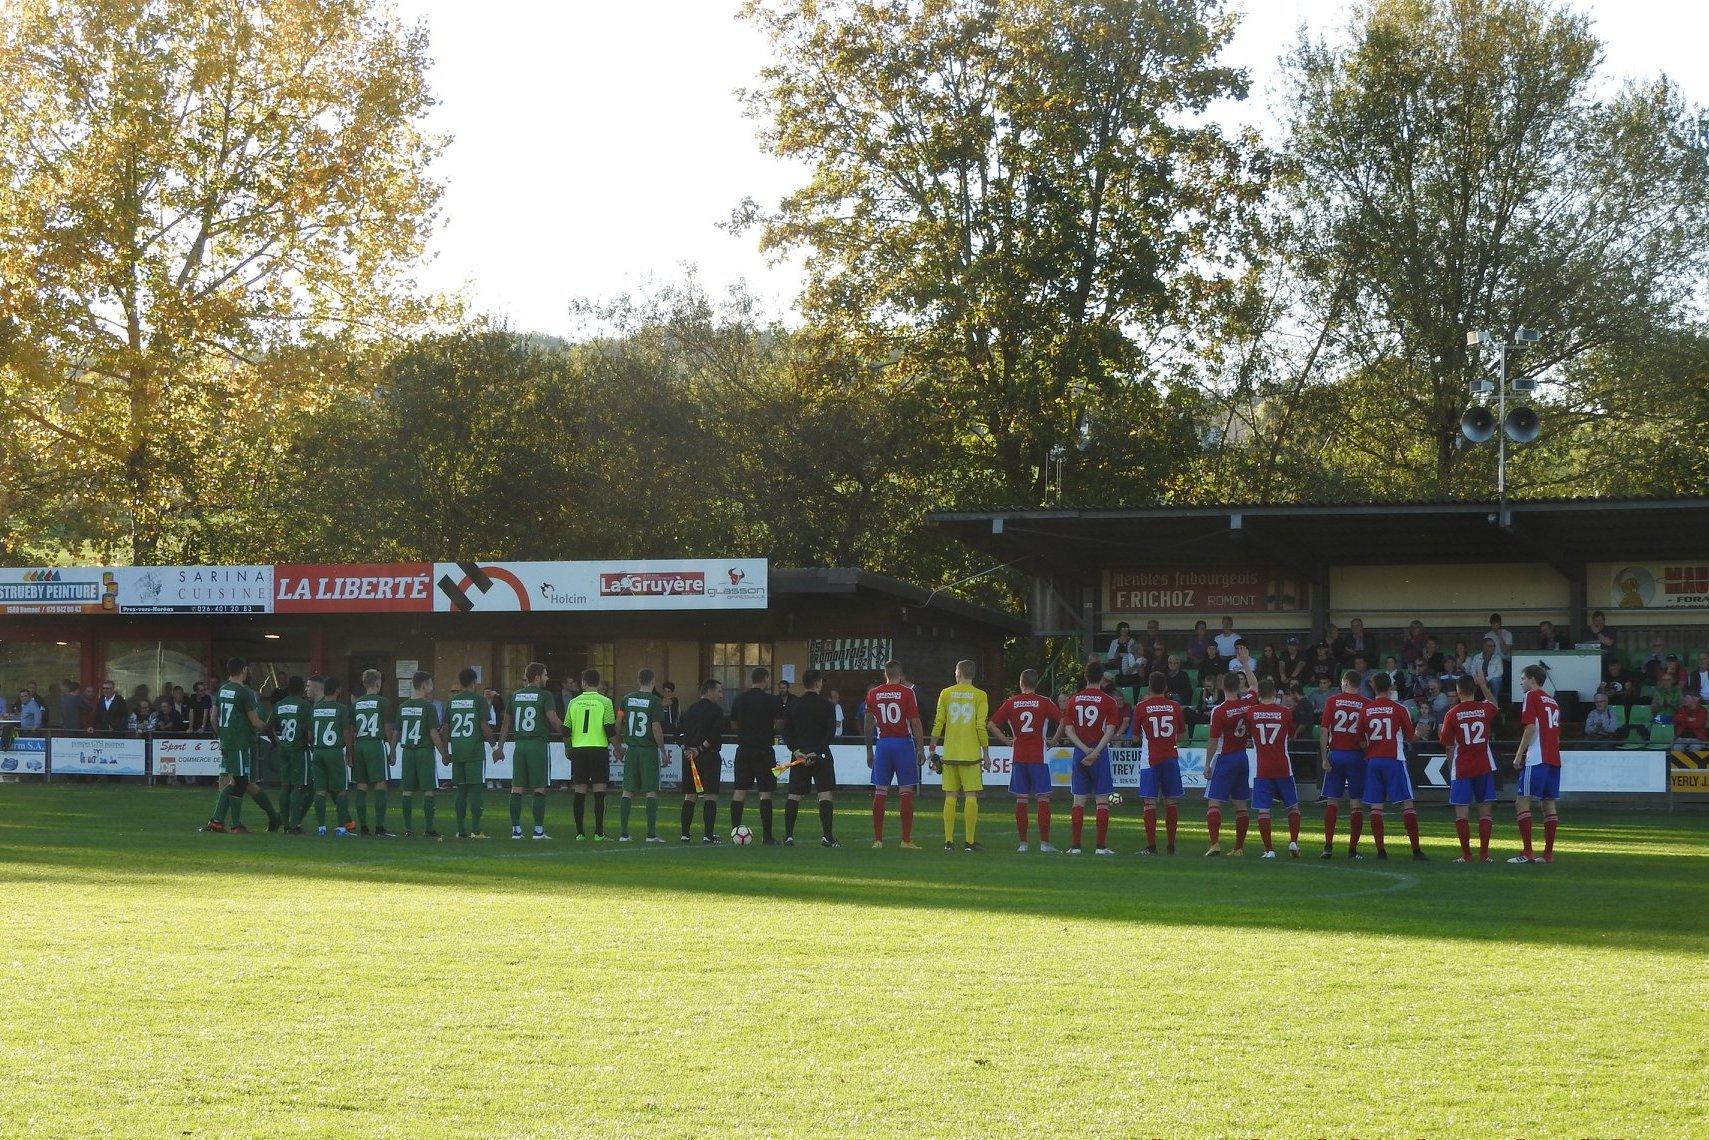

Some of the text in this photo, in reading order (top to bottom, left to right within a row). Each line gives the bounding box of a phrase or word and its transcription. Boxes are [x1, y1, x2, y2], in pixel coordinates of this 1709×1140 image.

[179, 571, 265, 582] SARINA
[276, 573, 430, 599] LA LIBERTÉ
[601, 575, 703, 595] La Gruyère
[46, 584, 97, 599] PEINTURE
[178, 588, 265, 600] CUISINE
[551, 594, 587, 604] Holcim
[1116, 590, 1257, 608] F.RICHOZ ROMONT
[218, 702, 234, 728] 17
[515, 706, 536, 732] 18
[583, 709, 590, 734] 1
[628, 711, 648, 737] 13
[877, 702, 901, 724] 10
[948, 703, 974, 724] 99
[1019, 711, 1034, 733] 2
[1075, 705, 1099, 727] 19
[1334, 710, 1359, 733] 22
[314, 720, 337, 746] 16
[356, 712, 379, 737] 24
[401, 720, 421, 747] 14
[451, 712, 475, 738] 25
[1149, 715, 1174, 738] 15
[1255, 723, 1282, 745] 17
[1369, 718, 1392, 741] 21
[1459, 721, 1486, 746] 12
[160, 740, 186, 752] Sport
[194, 743, 202, 751] &
[1671, 775, 1699, 787] YERLY
